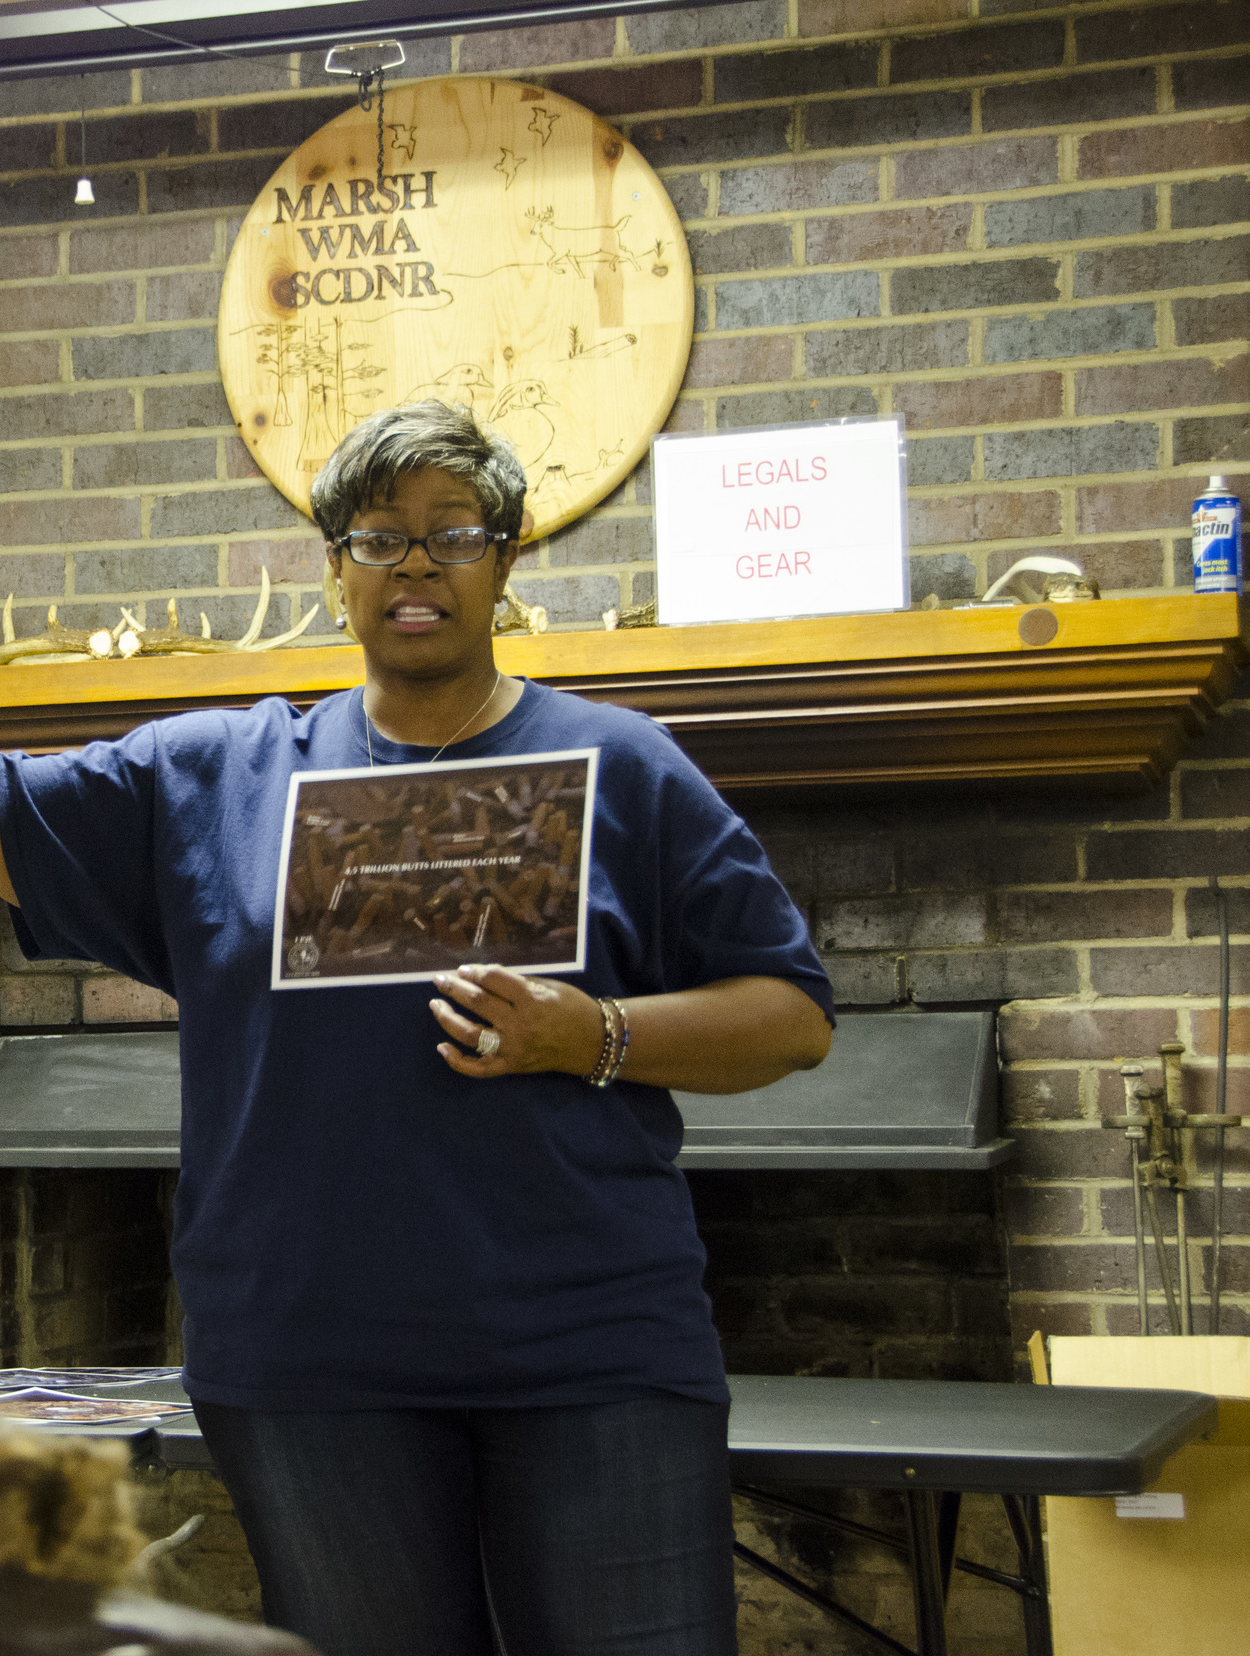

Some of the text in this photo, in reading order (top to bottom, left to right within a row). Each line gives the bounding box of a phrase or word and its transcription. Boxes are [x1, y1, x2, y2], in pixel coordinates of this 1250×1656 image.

[273, 171, 437, 224] MARSH
[298, 218, 420, 261] WMA
[290, 261, 439, 309] SCDNR
[722, 456, 828, 488] LEGALS
[744, 505, 801, 533] AND
[735, 551, 812, 580] GEAR
[359, 863, 400, 875] TRILLION
[430, 858, 471, 870] LITTERED
[472, 857, 497, 867] EACH
[498, 855, 521, 865] YEAR
